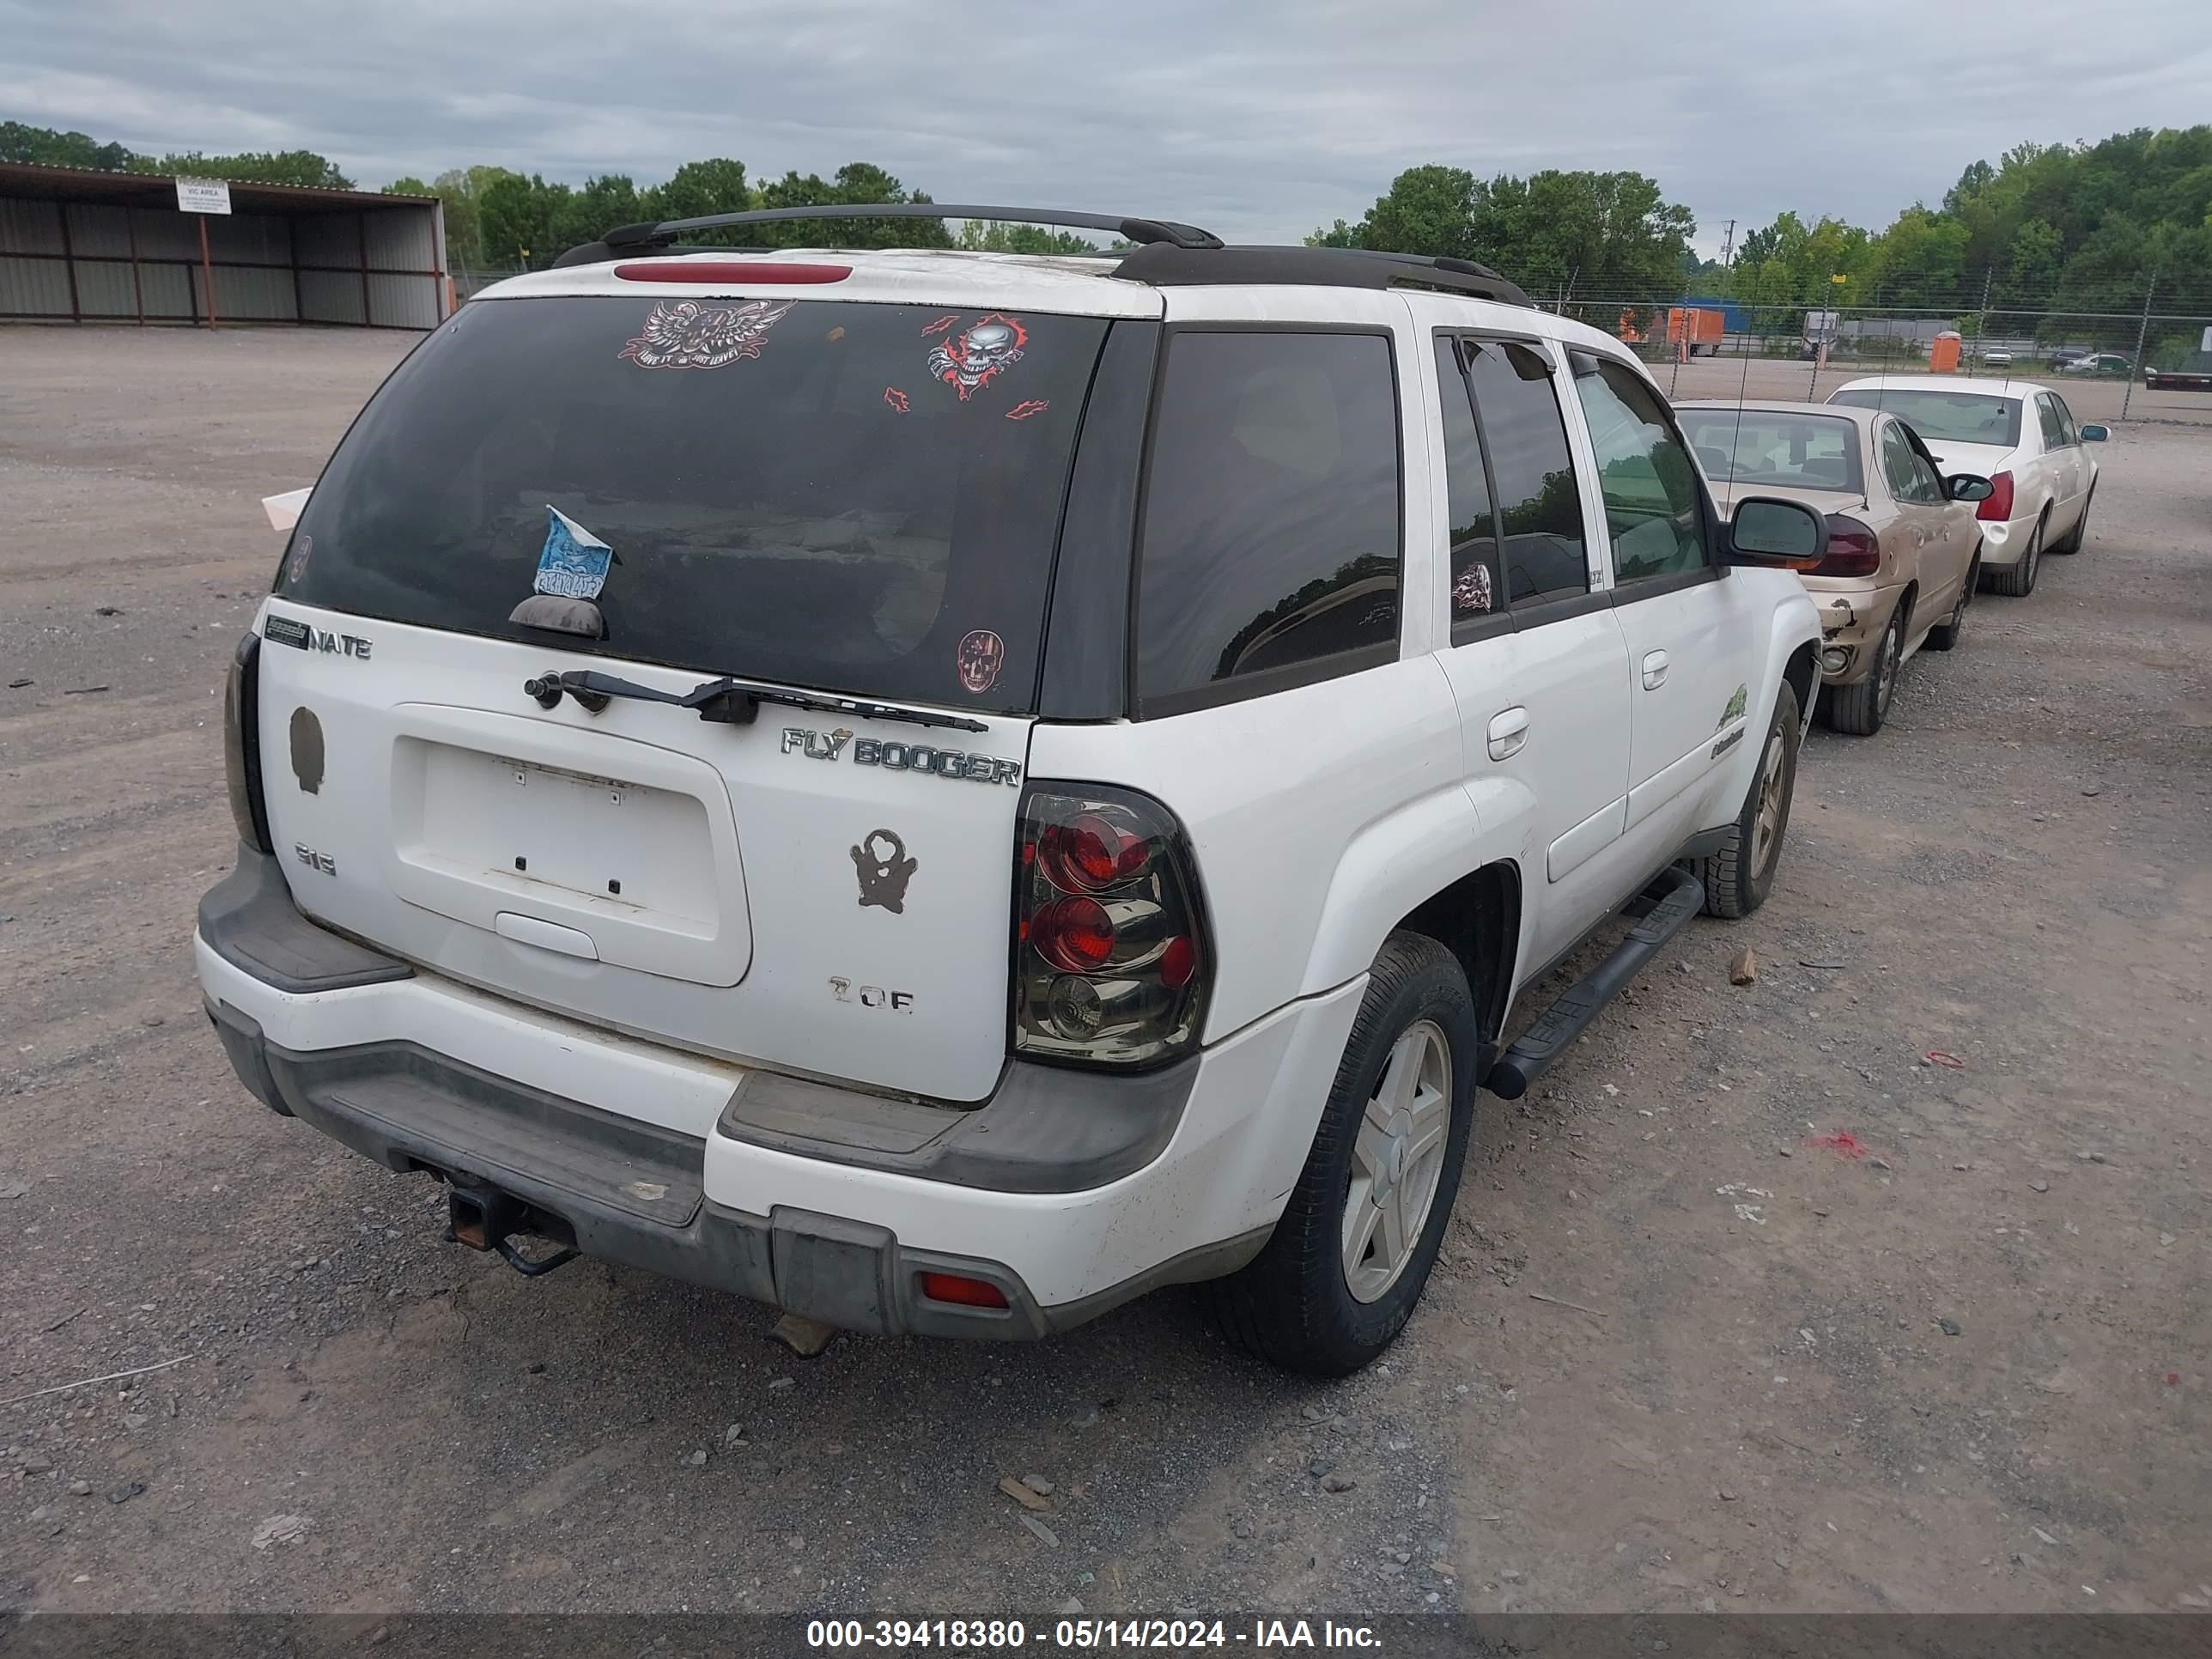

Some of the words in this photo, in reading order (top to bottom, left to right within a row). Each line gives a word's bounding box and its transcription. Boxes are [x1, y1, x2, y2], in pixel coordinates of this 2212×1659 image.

[308, 626, 373, 660] NATE
[780, 728, 851, 762] FLY
[854, 737, 1022, 787] BOOGER
